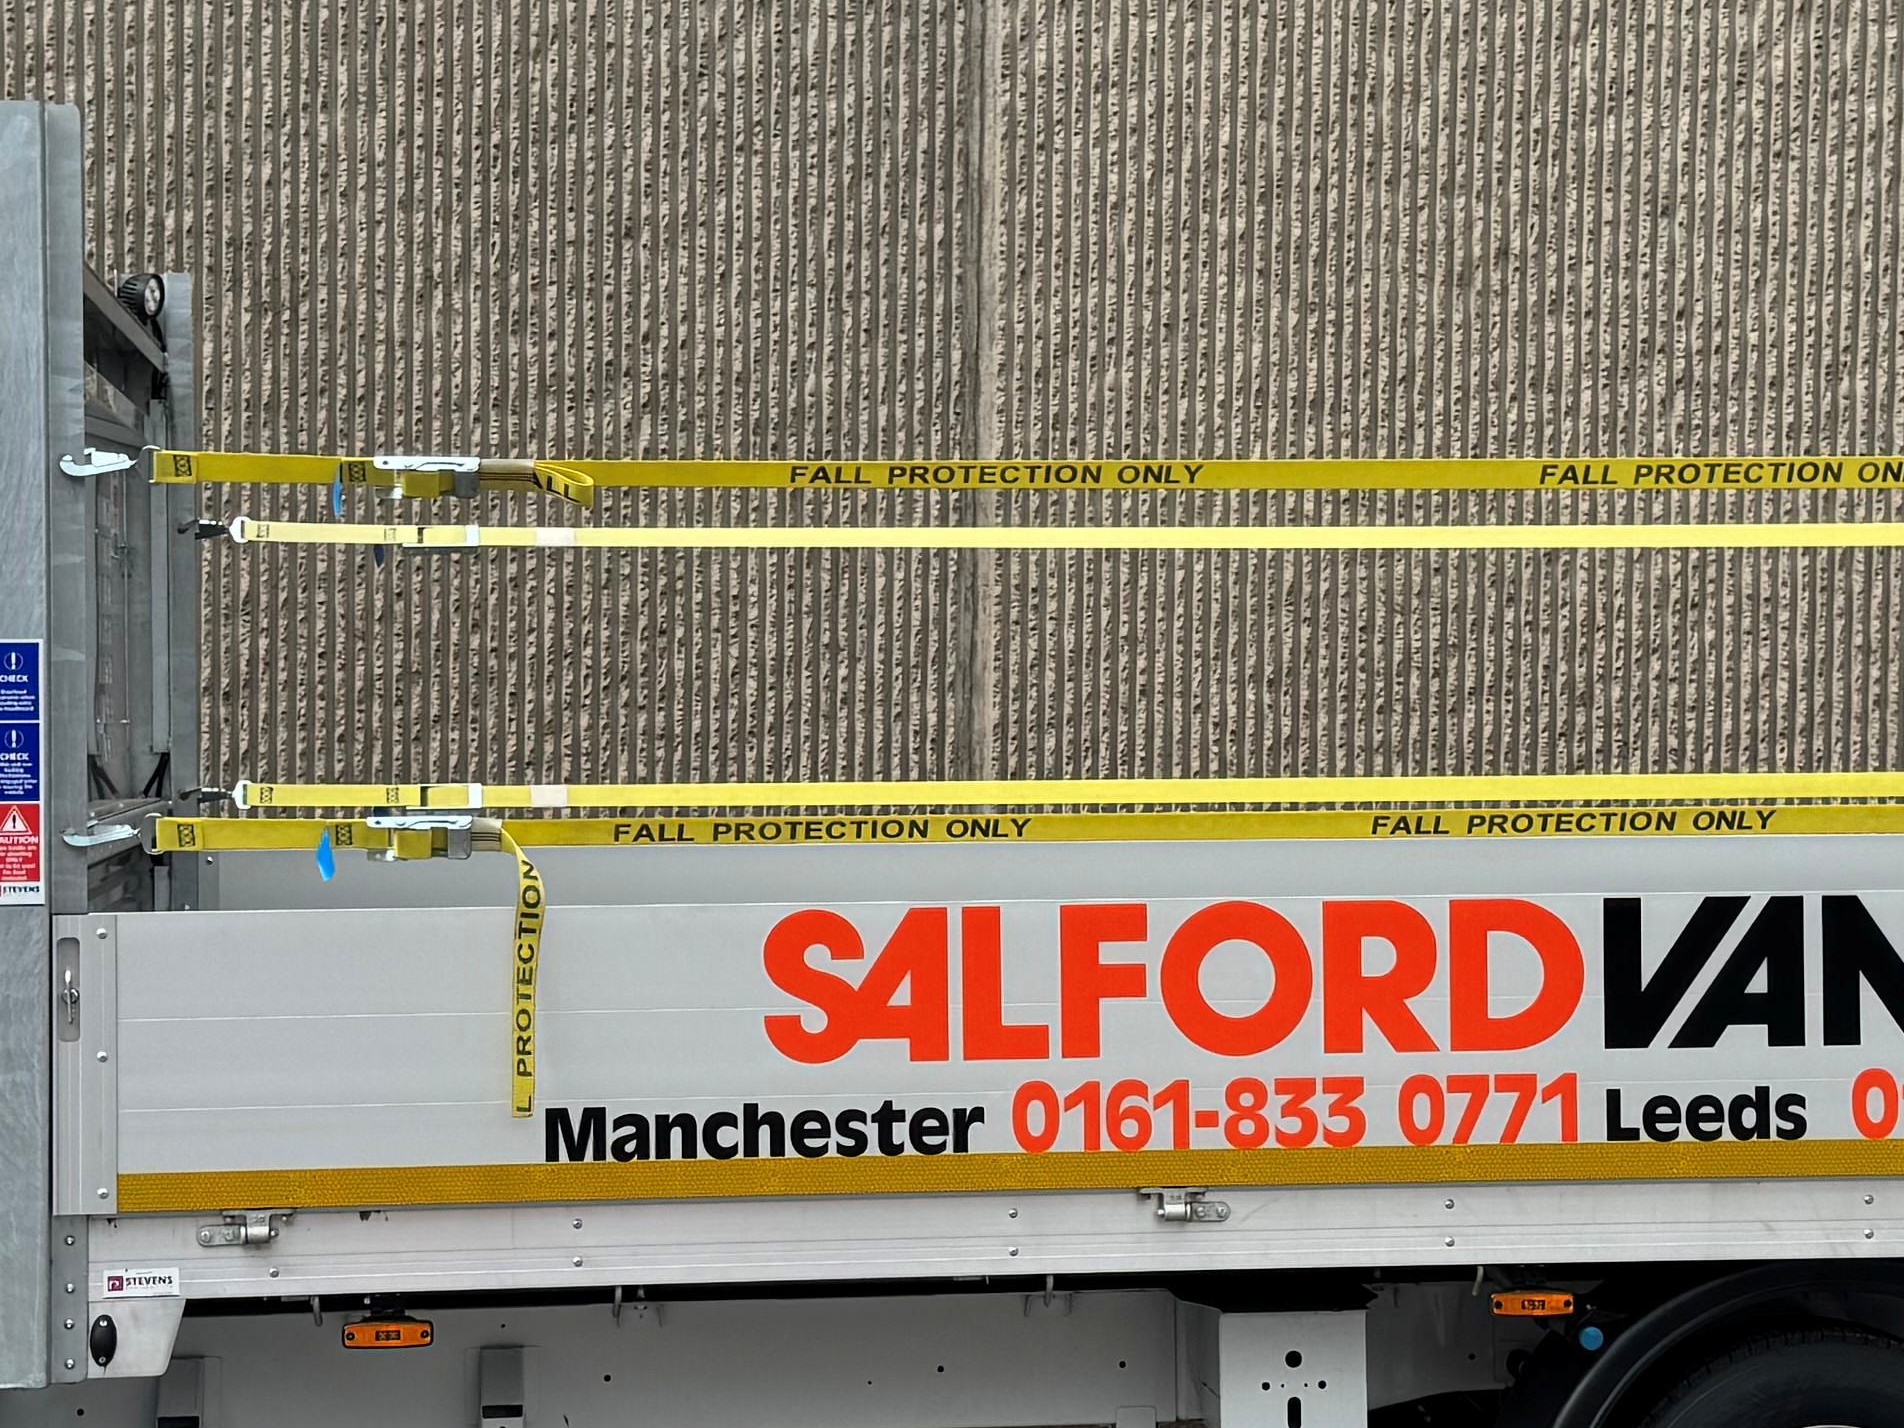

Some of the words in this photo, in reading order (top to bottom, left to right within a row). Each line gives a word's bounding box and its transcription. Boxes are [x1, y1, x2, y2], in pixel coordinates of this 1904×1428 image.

[790, 465, 872, 485] FALL
[887, 464, 1102, 485] PROTECTION
[1117, 464, 1203, 484] ONLY
[1539, 464, 1618, 485] FALL
[1634, 461, 1843, 485] PROTECTION
[614, 823, 695, 843] FALL
[712, 819, 929, 842] PROTECTION
[946, 818, 1031, 839] ONLY
[1371, 815, 1450, 835] FALL
[1467, 811, 1677, 835] PROTECTION
[1692, 809, 1776, 831] ONLY
[516, 860, 541, 1077] PROTECTION
[763, 898, 1585, 1065] SALFORD
[544, 1099, 985, 1163] Manchester
[1012, 1076, 1367, 1155] 0161-833
[1398, 1072, 1579, 1147] 0771
[1605, 1085, 1808, 1143] Leeds
[125, 1275, 173, 1286] STEVENS
